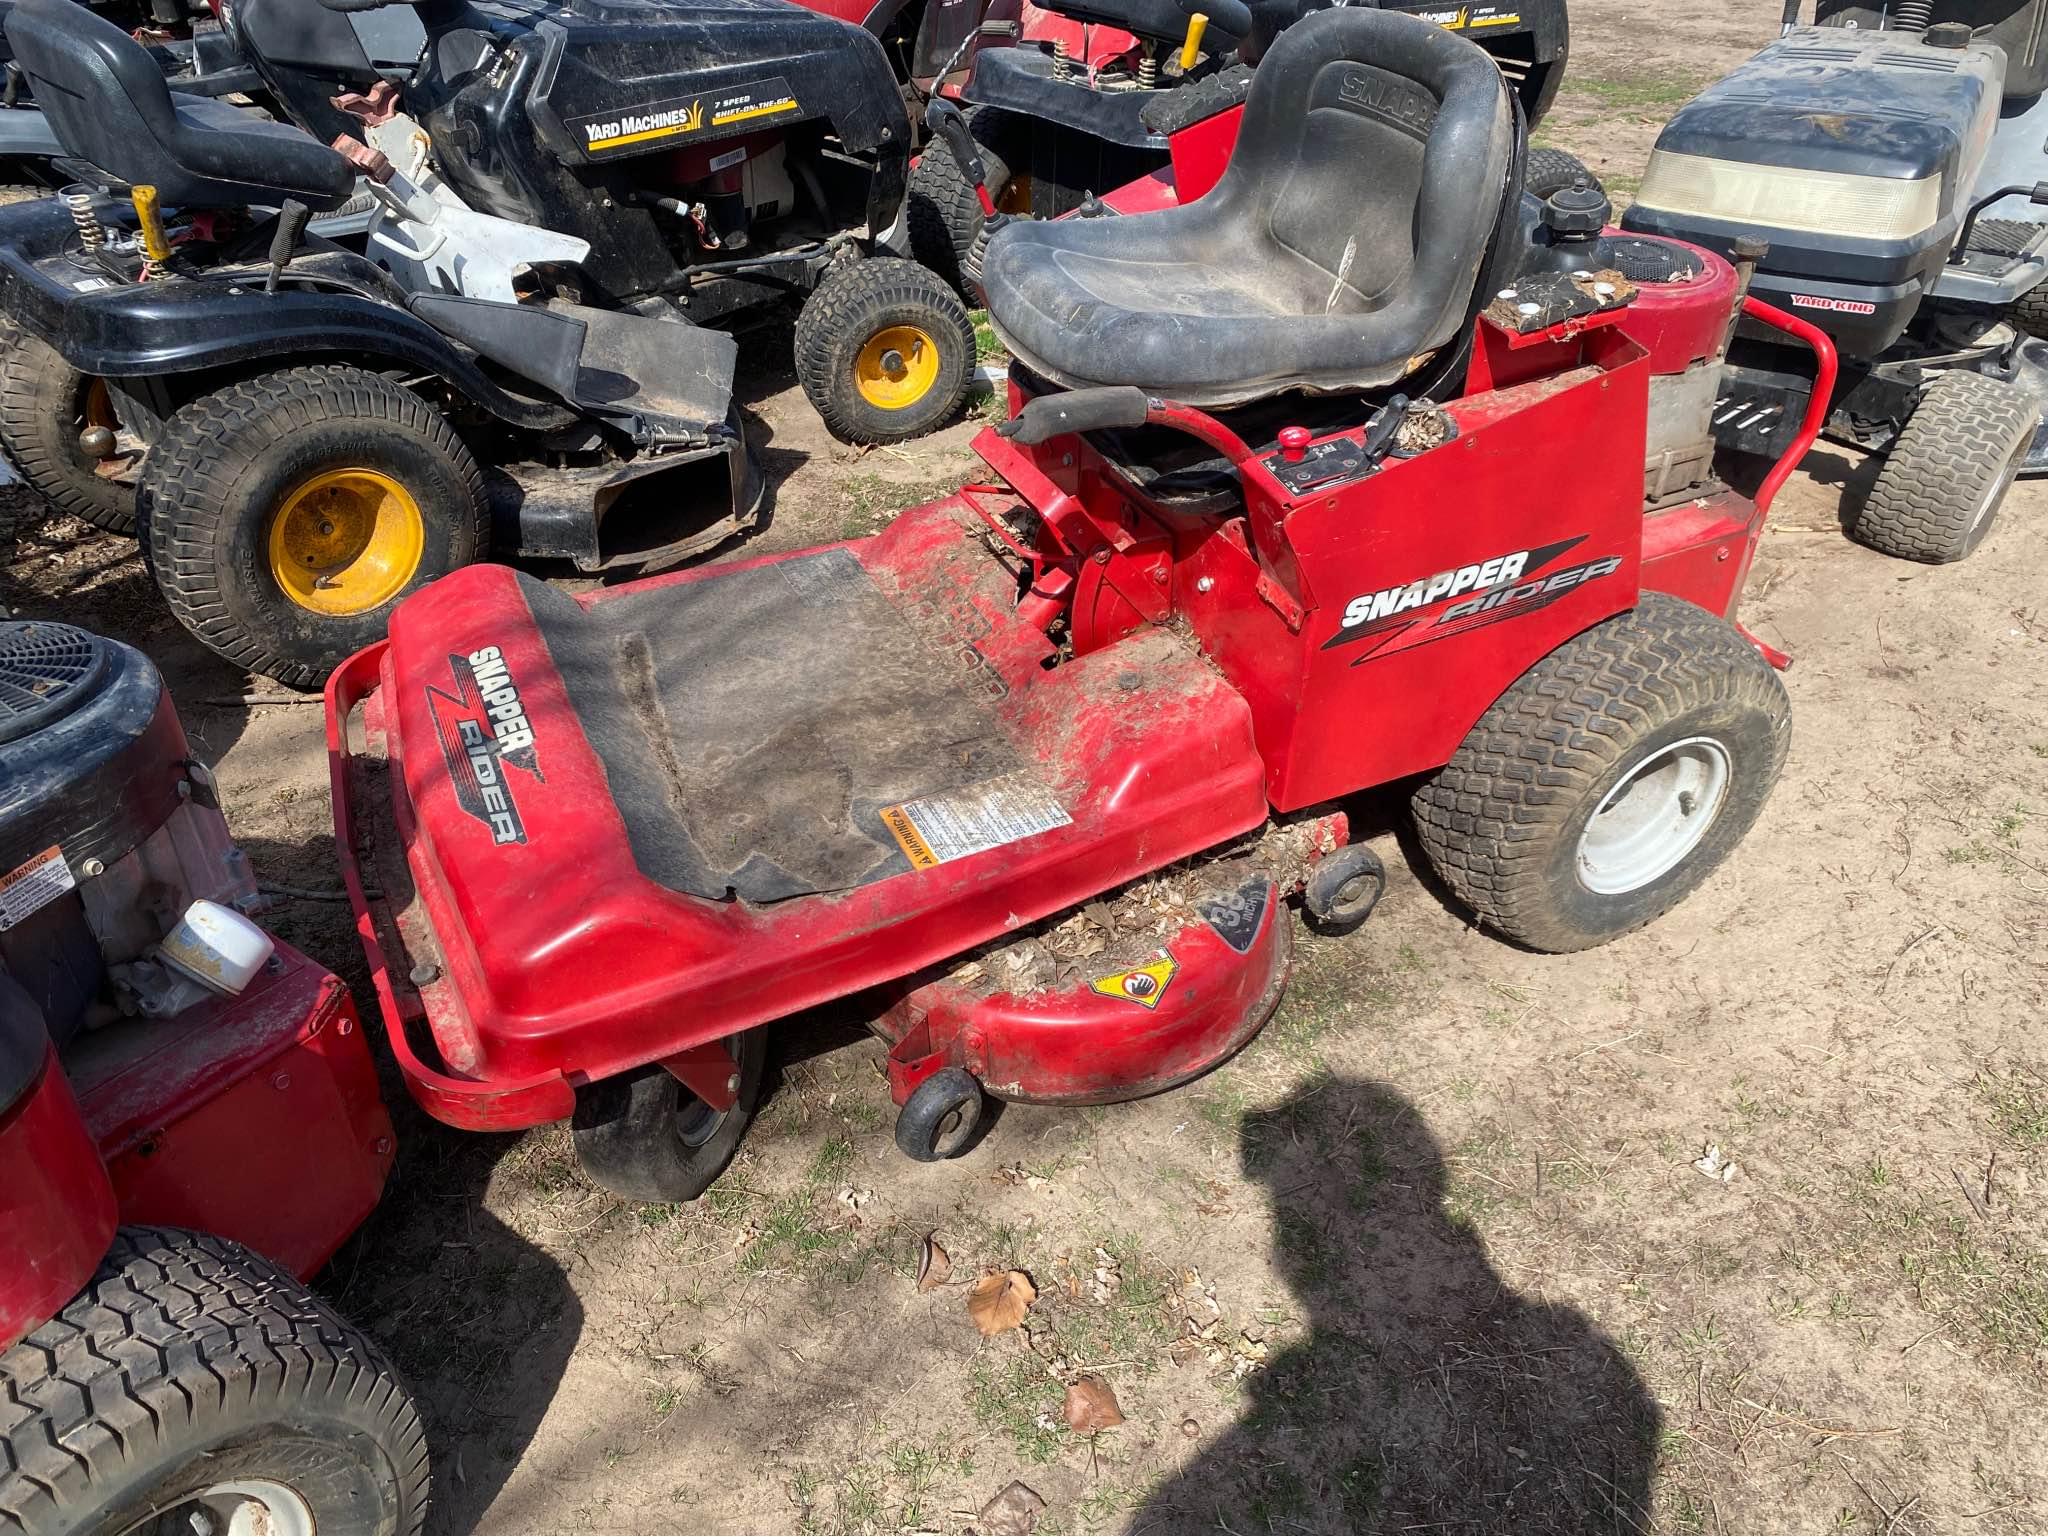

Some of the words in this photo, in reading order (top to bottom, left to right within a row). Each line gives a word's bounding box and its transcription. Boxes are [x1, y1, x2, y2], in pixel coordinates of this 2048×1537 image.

[714, 101, 721, 109] 7
[722, 95, 751, 108] SPEED
[1340, 70, 1440, 132] SNAPP
[585, 120, 620, 142] YARD
[621, 108, 688, 135] MACHINES
[1791, 294, 1832, 309] YARD
[1833, 300, 1875, 314] KING
[1341, 550, 1529, 629] SNAPPER
[1437, 556, 1623, 624] RIDER
[468, 645, 535, 755] SNAPPER
[458, 719, 518, 844] RIDER
[893, 818, 926, 859] WARNING
[2, 854, 49, 888] WARNING
[1210, 893, 1246, 928] 38
[1240, 898, 1258, 922] INCH
